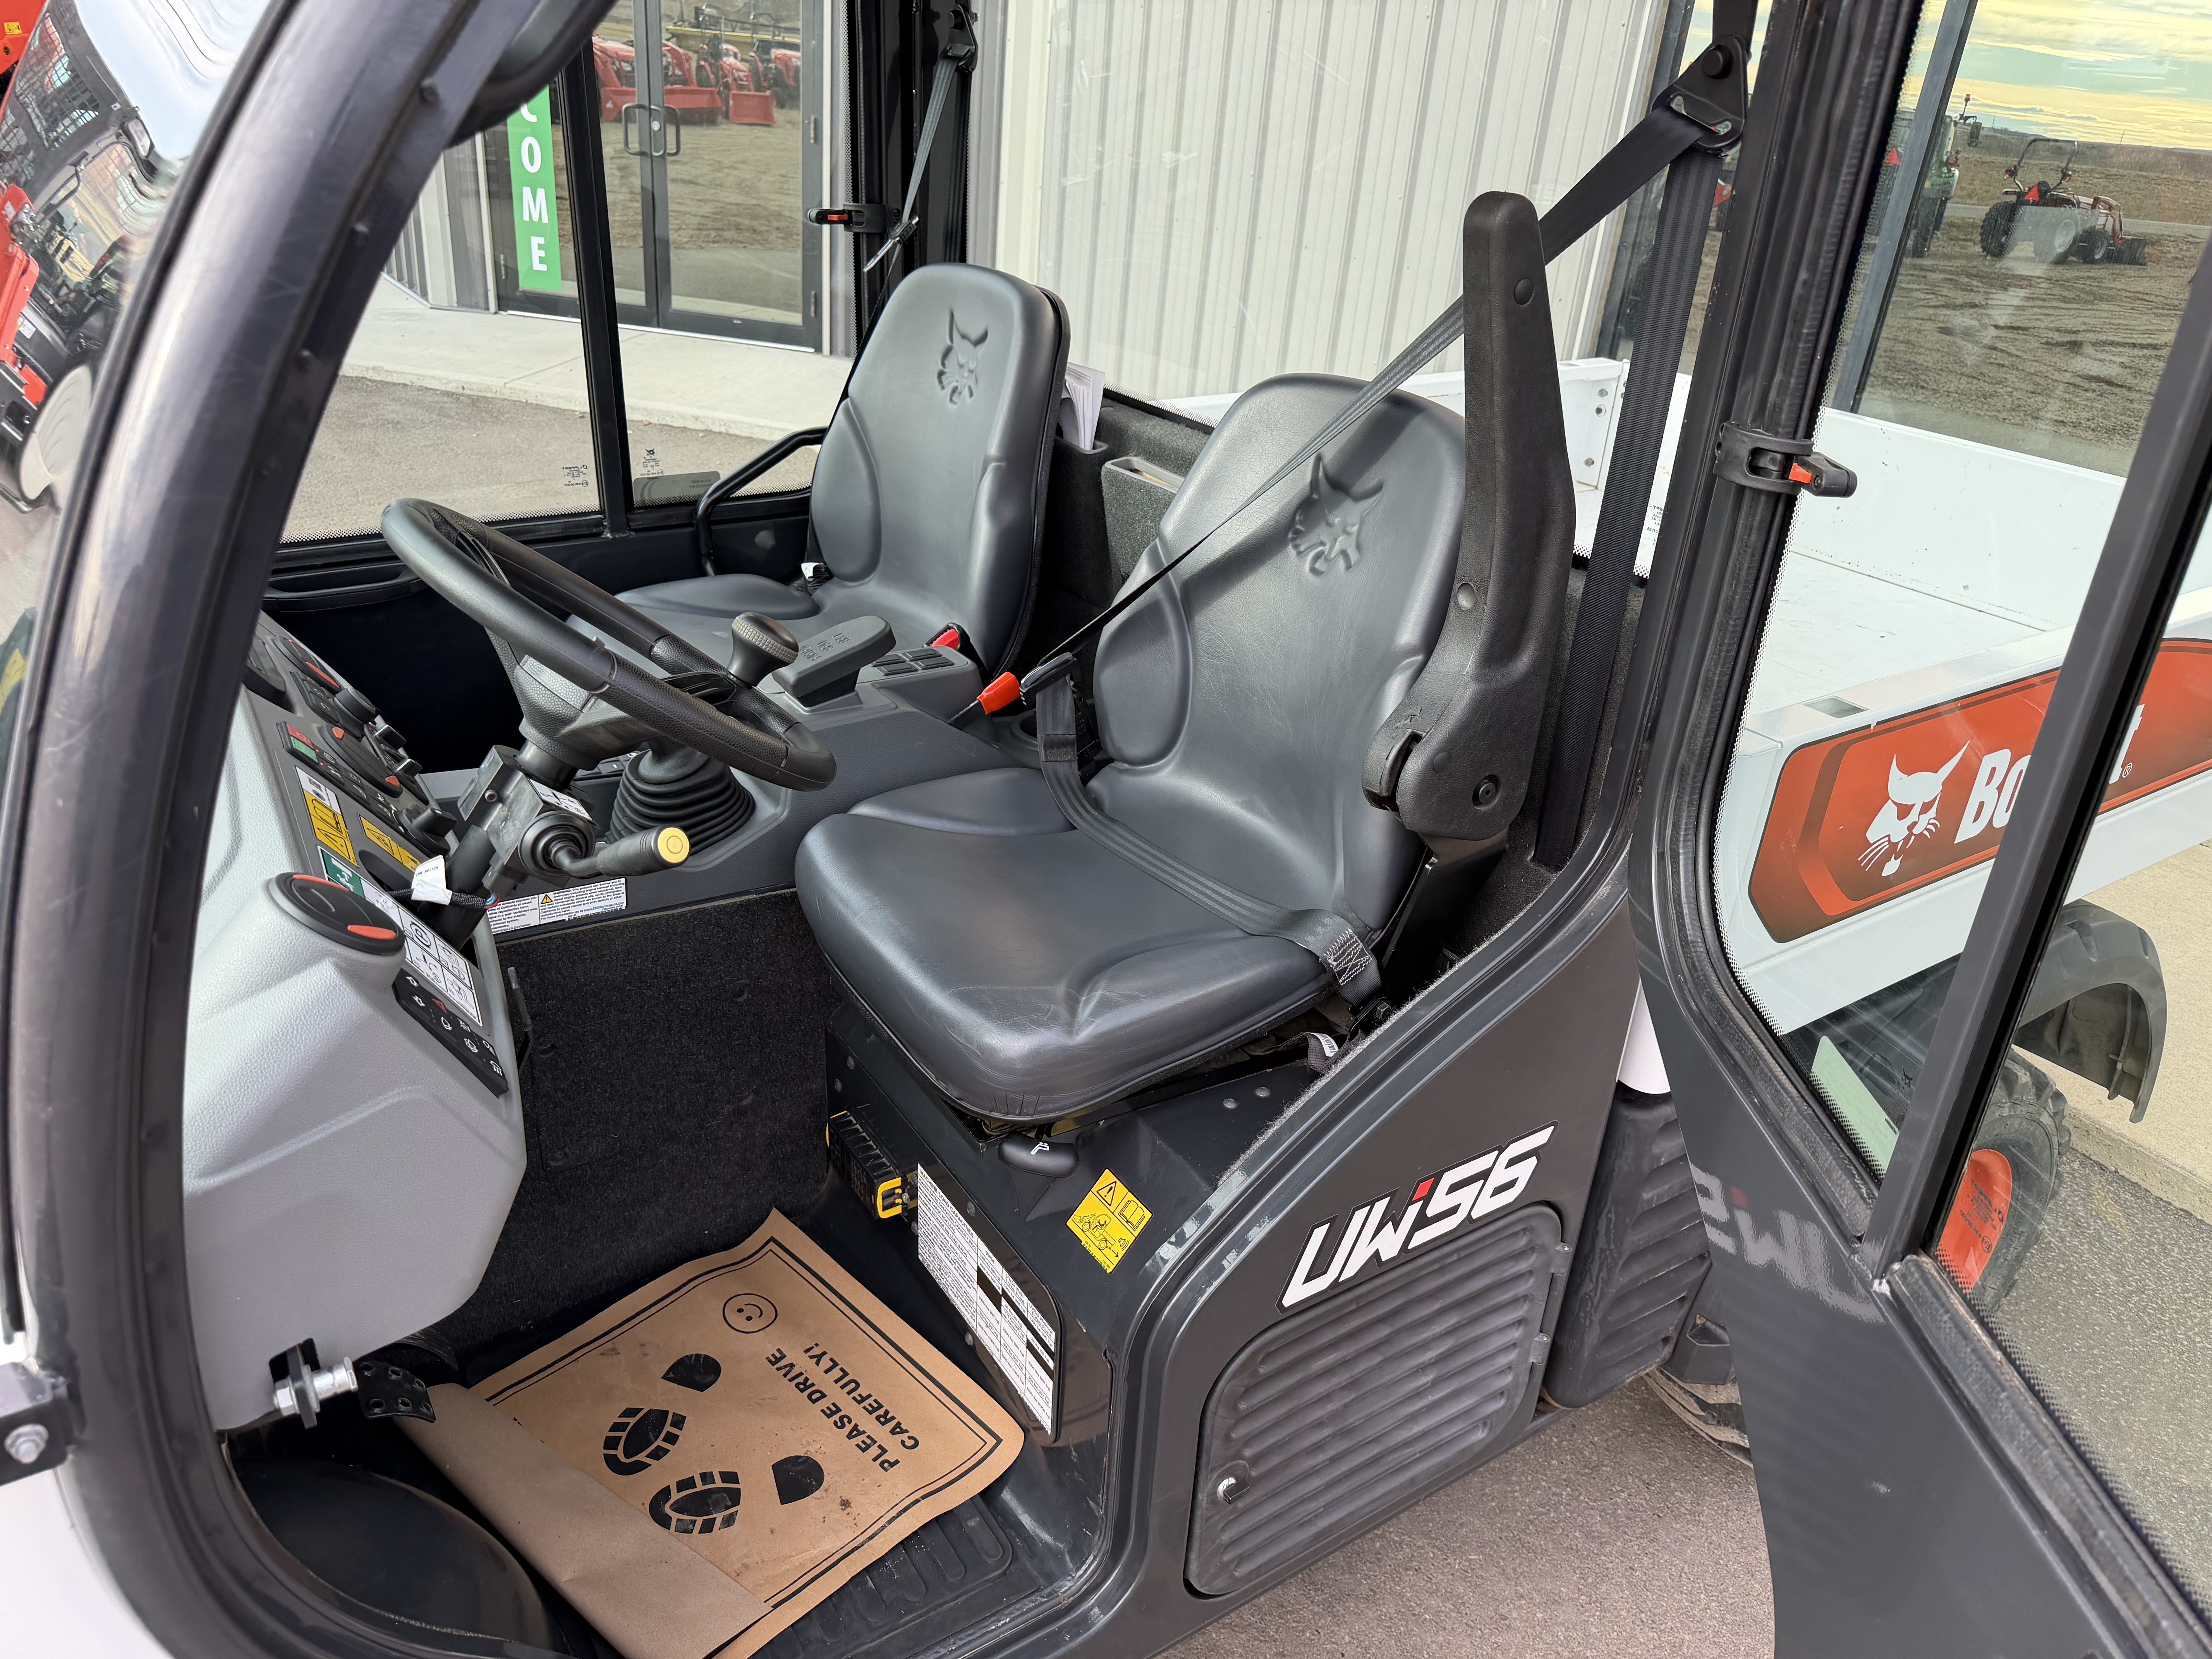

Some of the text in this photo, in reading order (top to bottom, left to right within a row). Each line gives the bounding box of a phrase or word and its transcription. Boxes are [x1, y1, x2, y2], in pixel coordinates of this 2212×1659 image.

[765, 1347, 901, 1472] PLEASE DRIVE
[803, 1342, 920, 1450] CAREFULLY!
